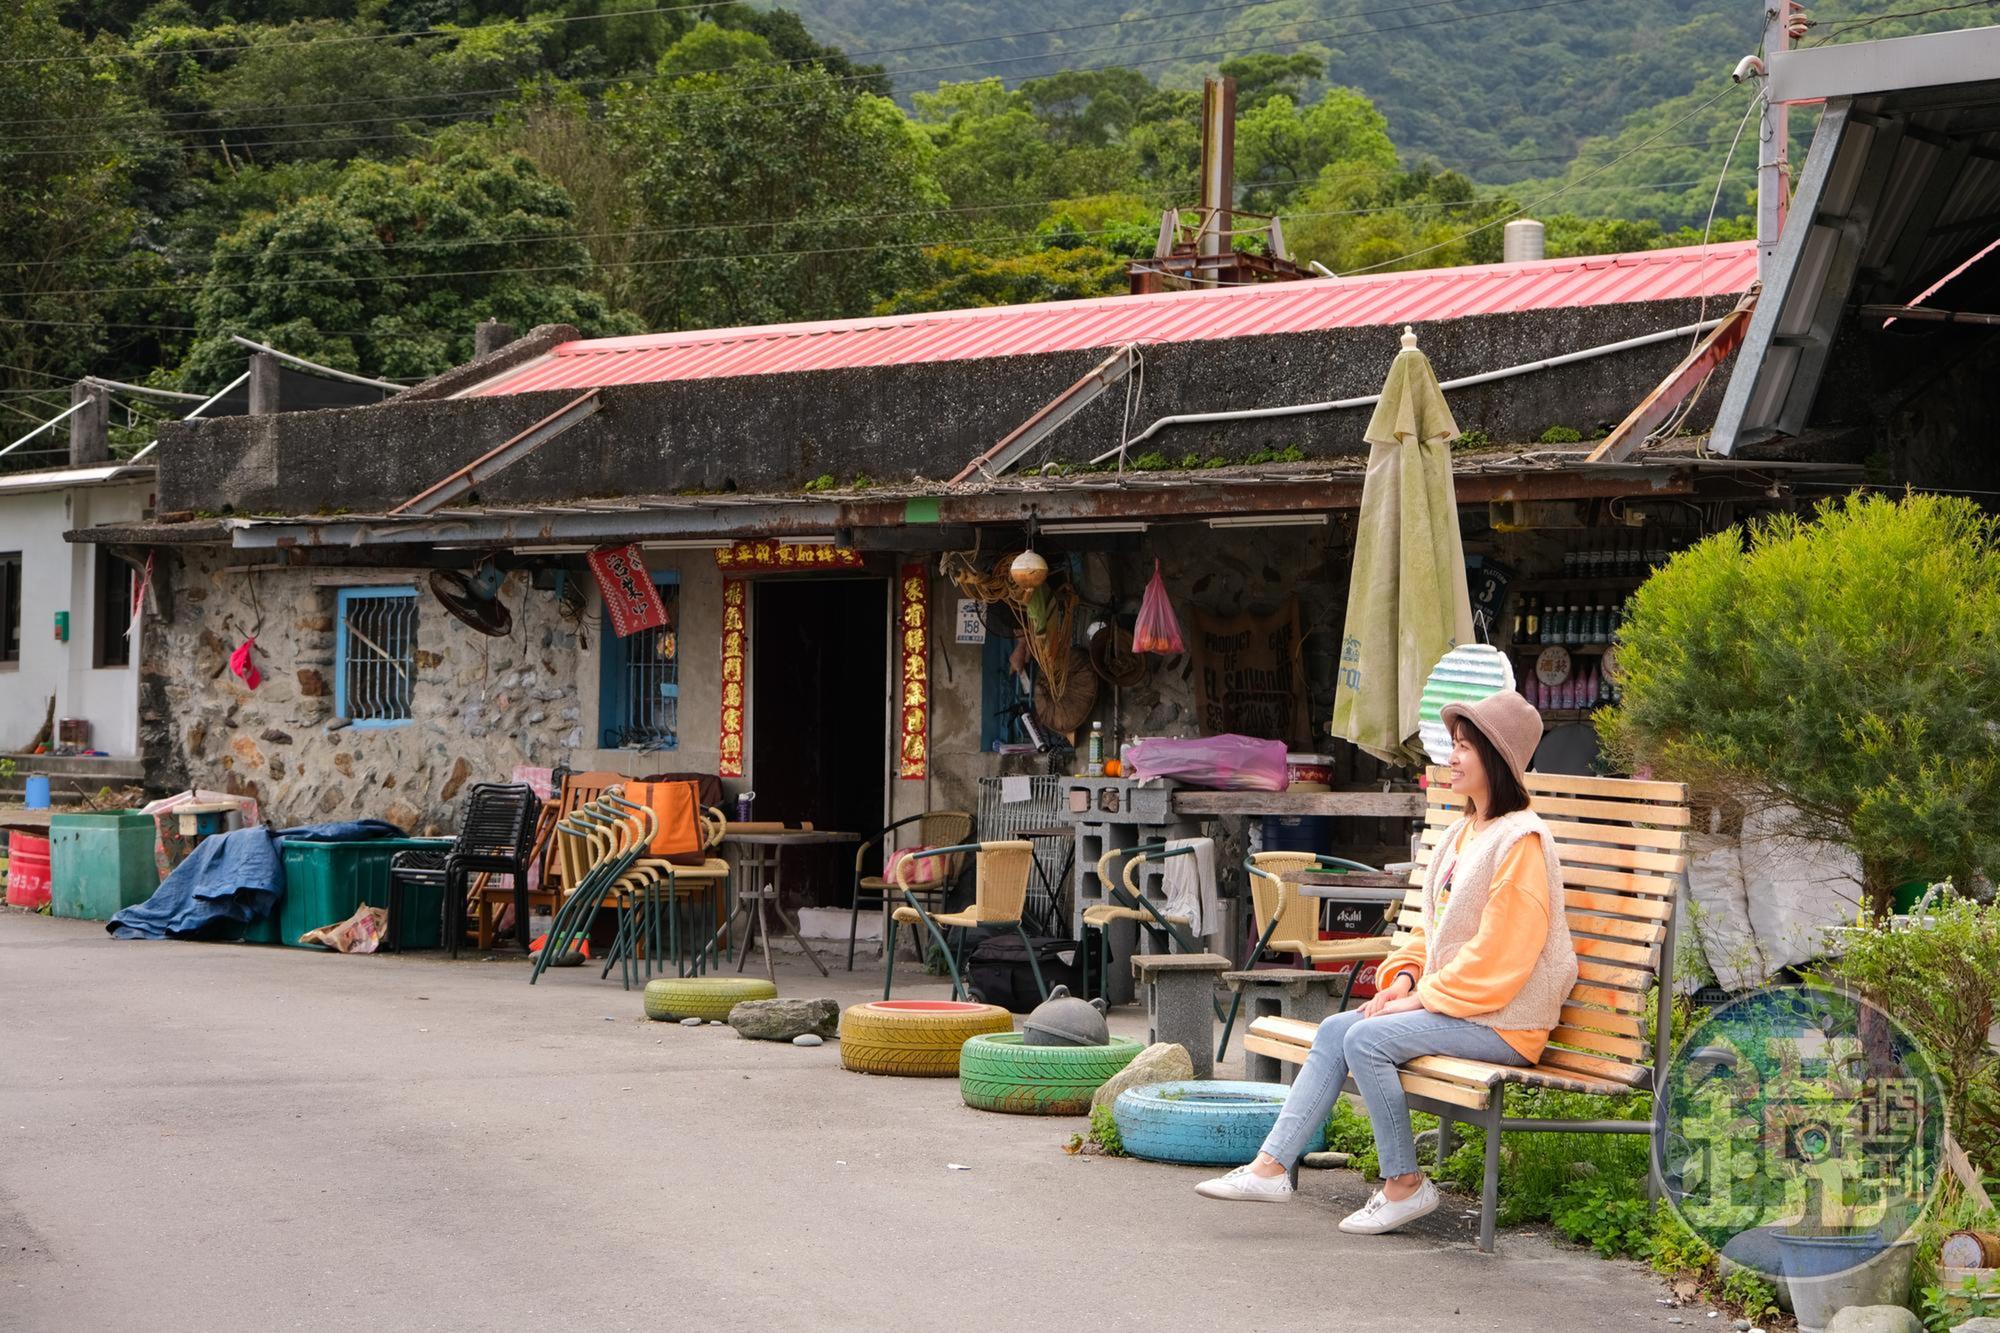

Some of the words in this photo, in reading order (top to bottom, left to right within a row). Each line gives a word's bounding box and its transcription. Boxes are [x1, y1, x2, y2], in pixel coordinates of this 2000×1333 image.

[1479, 580, 1496, 602] 3
[964, 620, 980, 634] 158
[1205, 631, 1251, 653] PRODUCT
[1223, 653, 1238, 672] OF
[1337, 910, 1361, 922] Asahi
